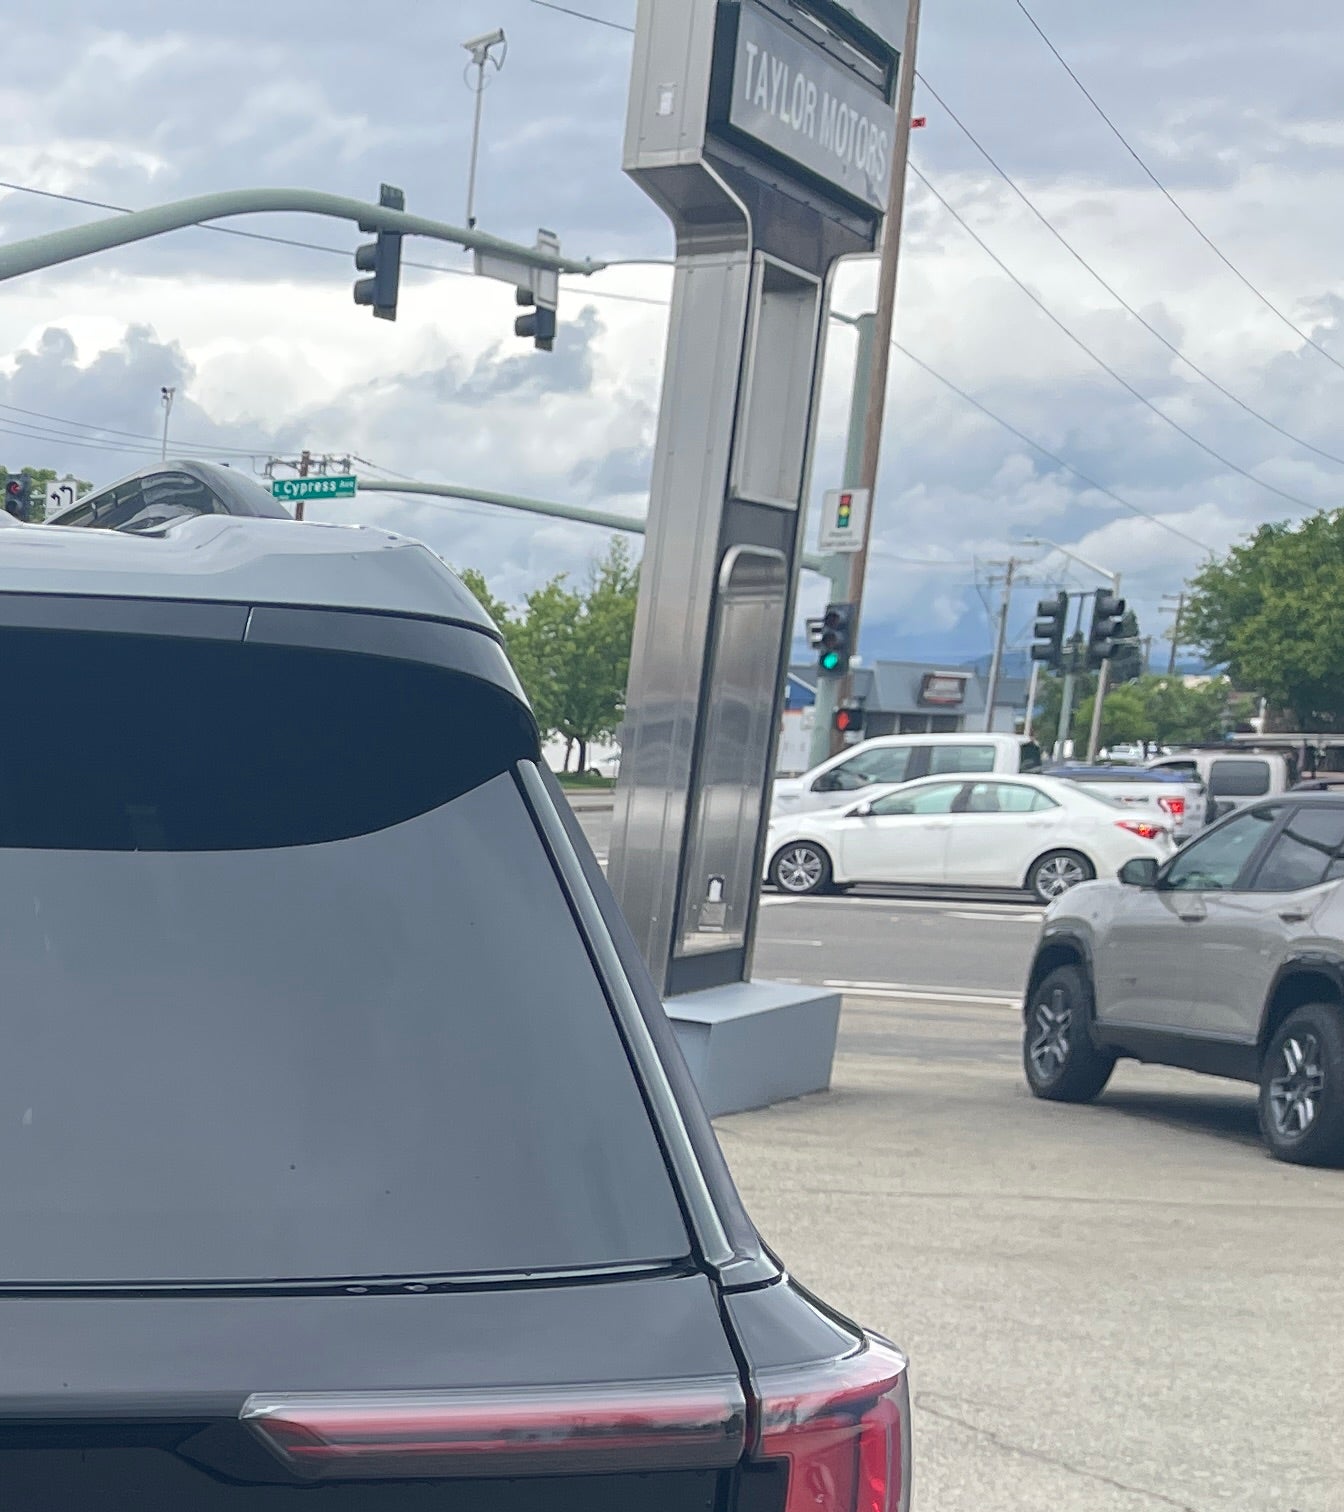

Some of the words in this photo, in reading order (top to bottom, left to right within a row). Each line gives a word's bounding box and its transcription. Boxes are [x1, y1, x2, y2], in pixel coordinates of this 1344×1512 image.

[744, 41, 817, 140] TAYLOR
[819, 92, 889, 182] MOTORS
[283, 480, 337, 496] Cypress
